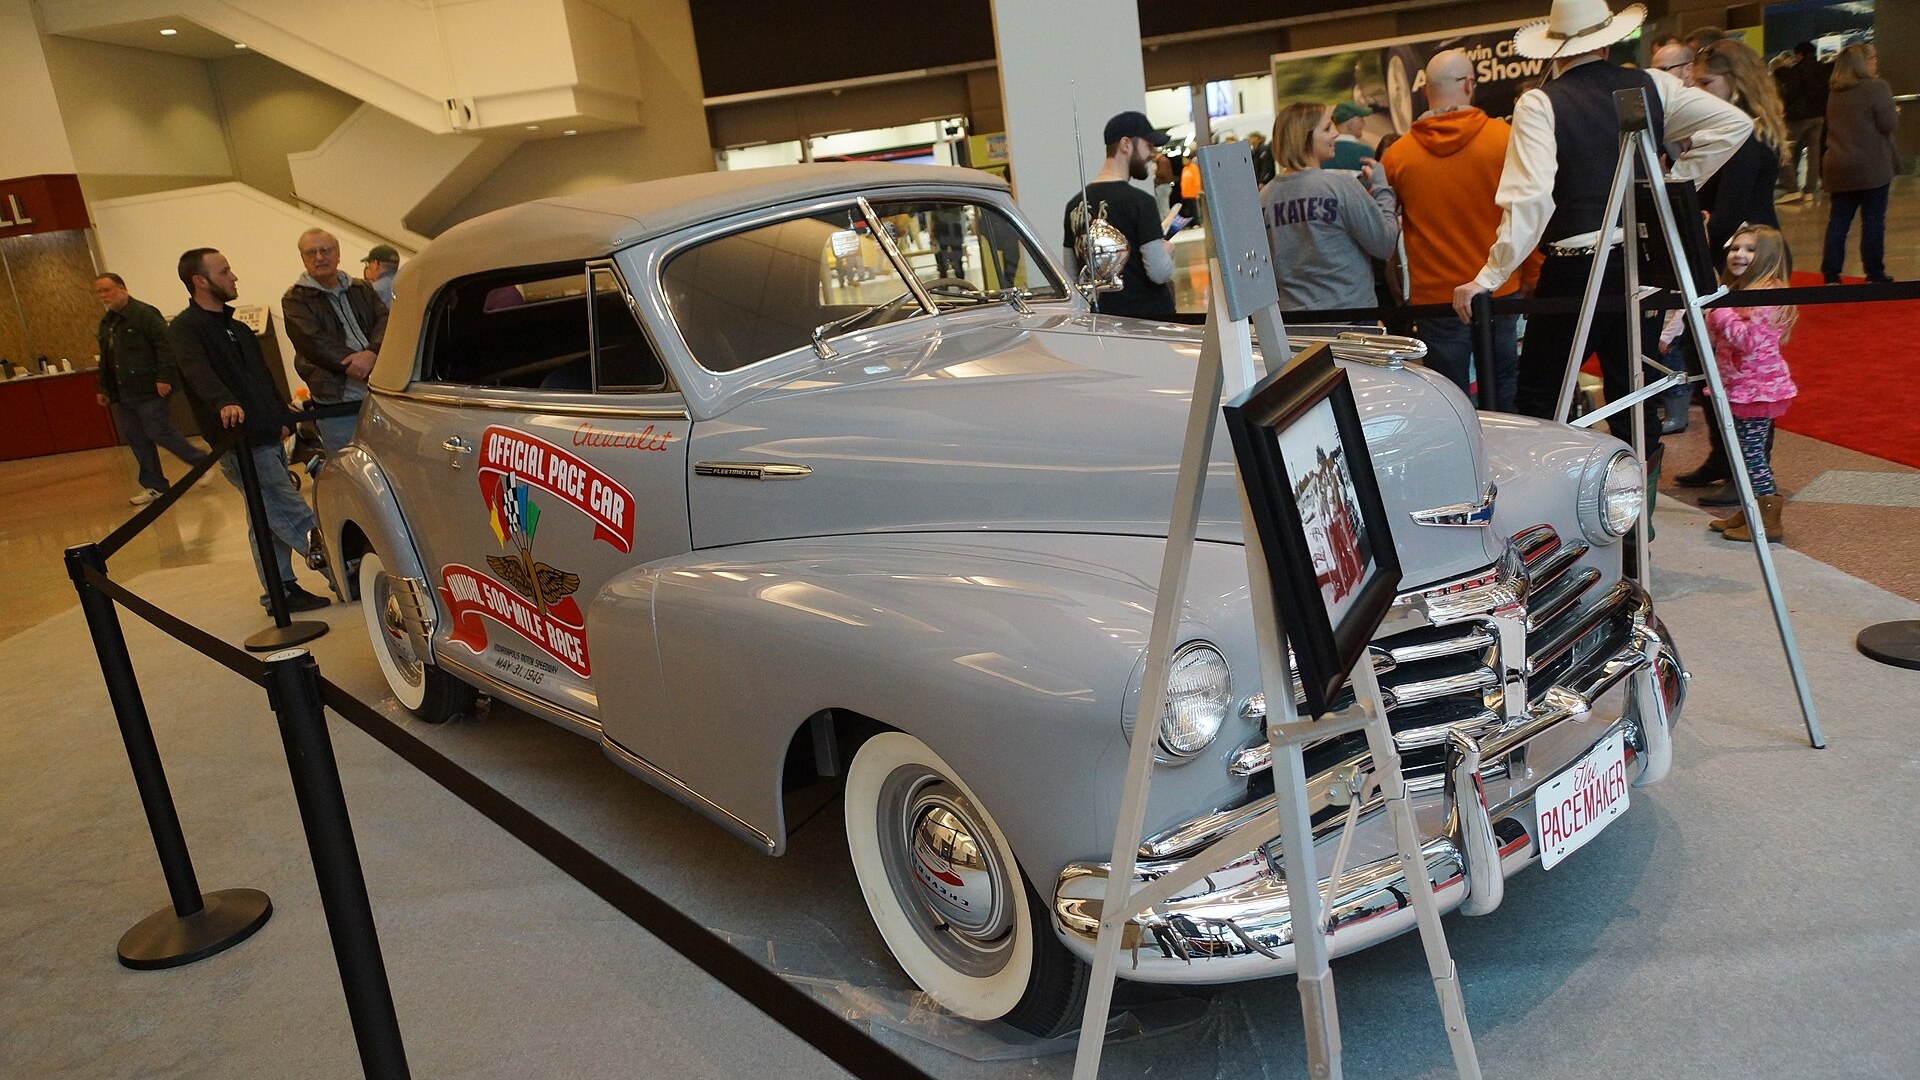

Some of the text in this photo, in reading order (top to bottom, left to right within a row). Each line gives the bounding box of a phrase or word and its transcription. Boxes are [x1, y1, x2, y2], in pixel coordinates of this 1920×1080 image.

[1453, 45, 1492, 61] win
[1476, 58, 1543, 84] Show
[1274, 197, 1339, 227] KATE'S
[573, 422, 673, 452] Chevrolet
[488, 433, 625, 529] OFFICIAL PACE CAR
[713, 468, 759, 477] FLEETMASTER
[482, 582, 545, 642] 500-MILE
[545, 620, 586, 668] RACE
[495, 657, 514, 672] MAY
[523, 668, 545, 685] 1948
[1540, 759, 1626, 853] PACEMAKER
